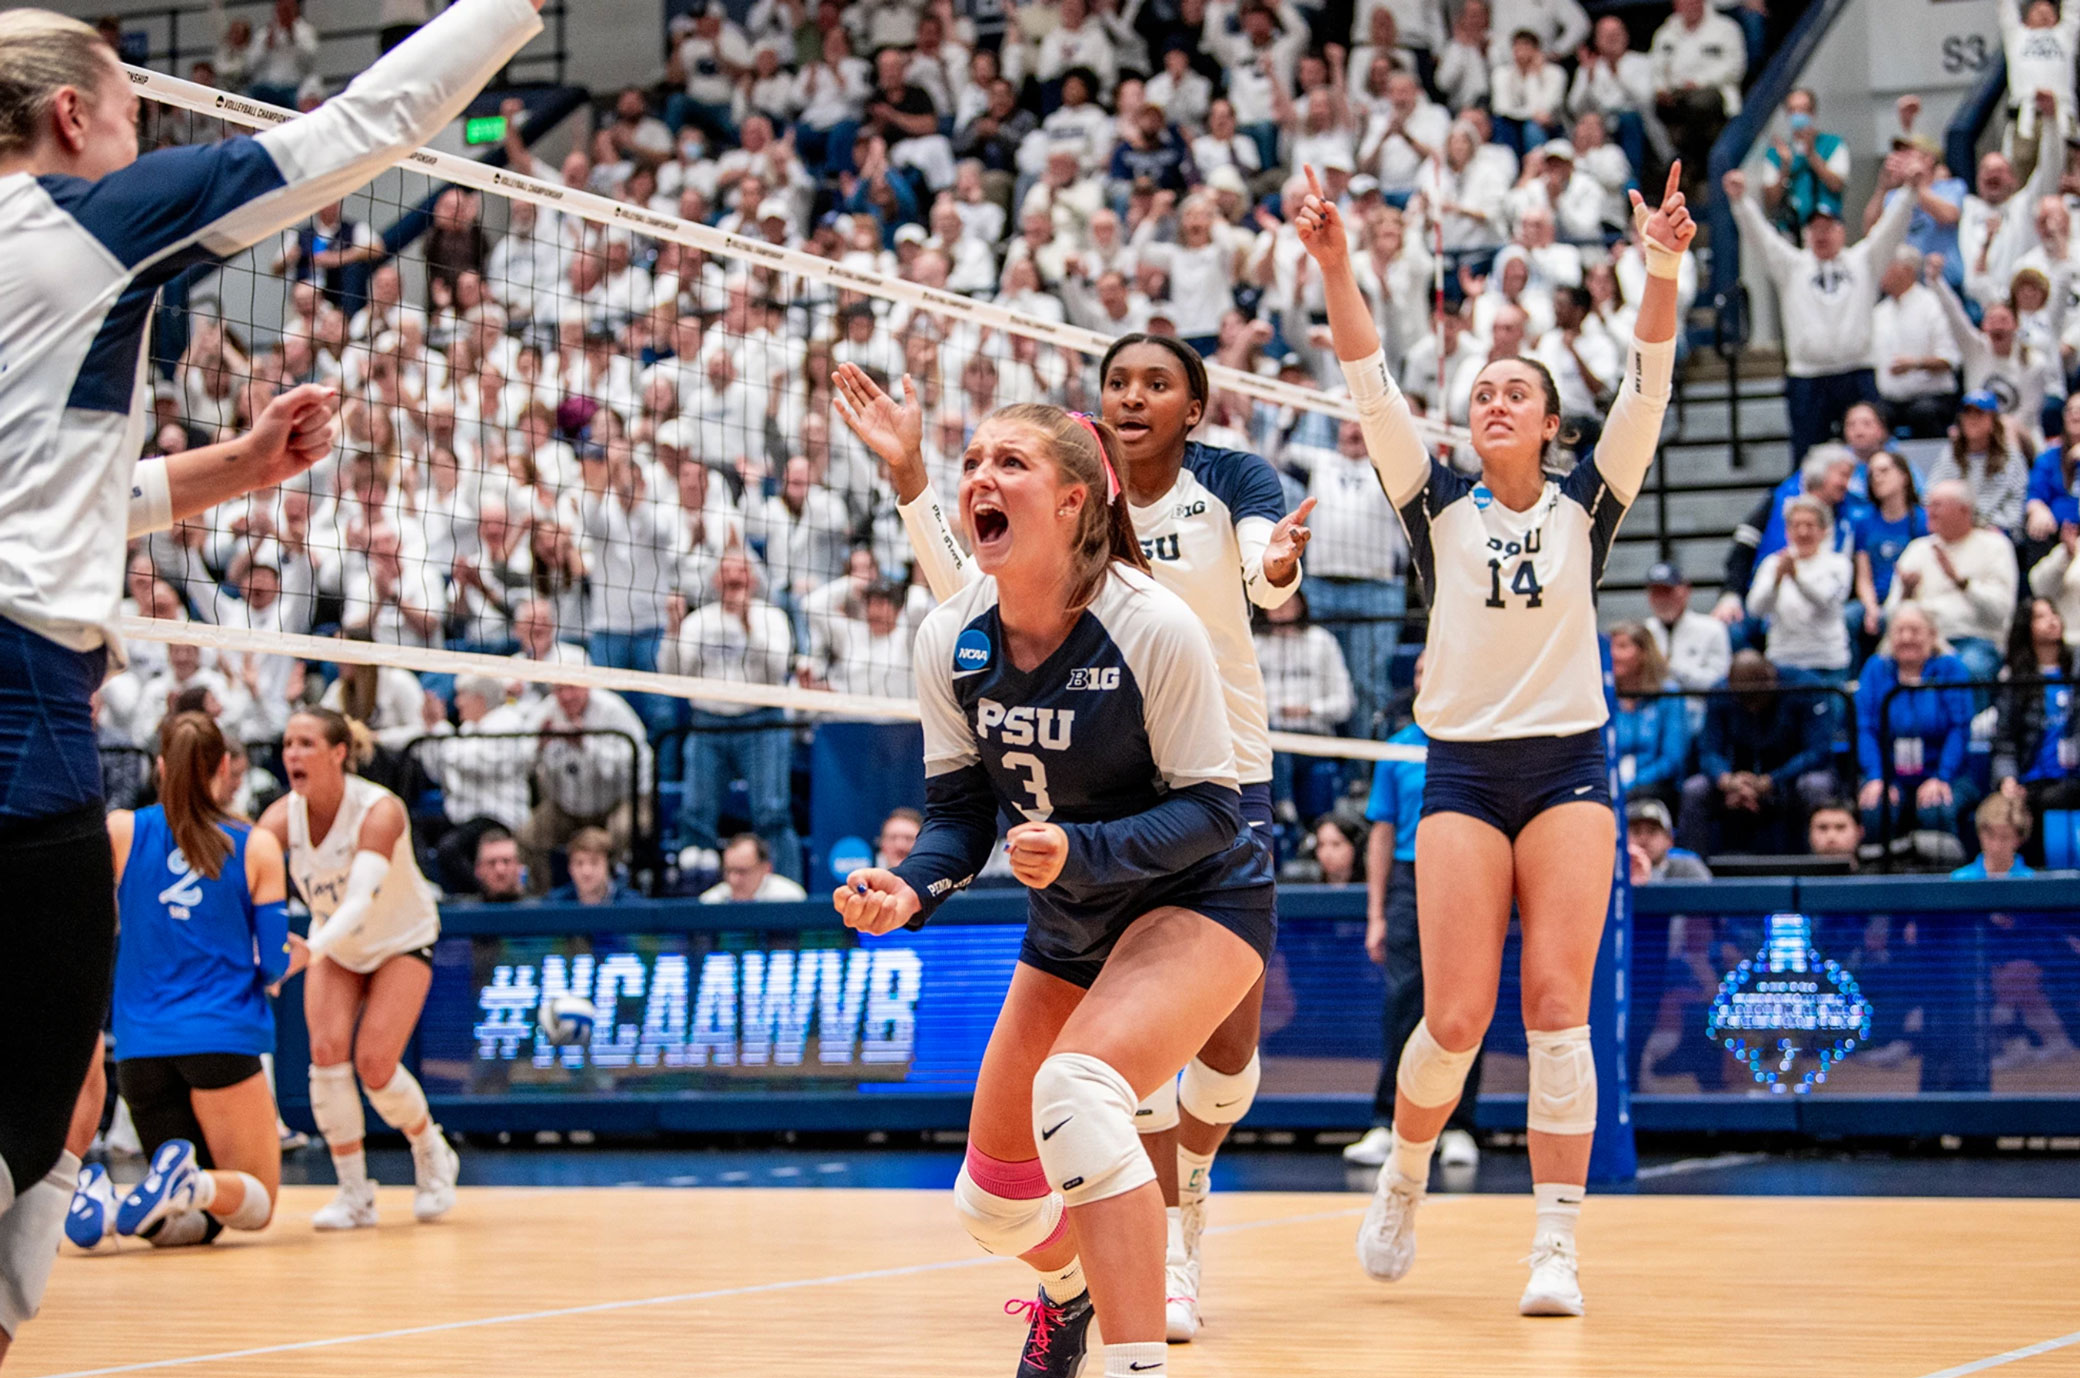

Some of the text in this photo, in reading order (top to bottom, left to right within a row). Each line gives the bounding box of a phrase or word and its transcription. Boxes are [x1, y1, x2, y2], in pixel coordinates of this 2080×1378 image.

[1942, 34, 1988, 74] S3
[223, 99, 257, 117] VOLLEYBALL
[1138, 532, 1181, 561] SU
[1485, 558, 1543, 609] 14
[959, 647, 988, 661] NCAA
[976, 697, 1076, 751] PSU
[1001, 751, 1054, 823] 3
